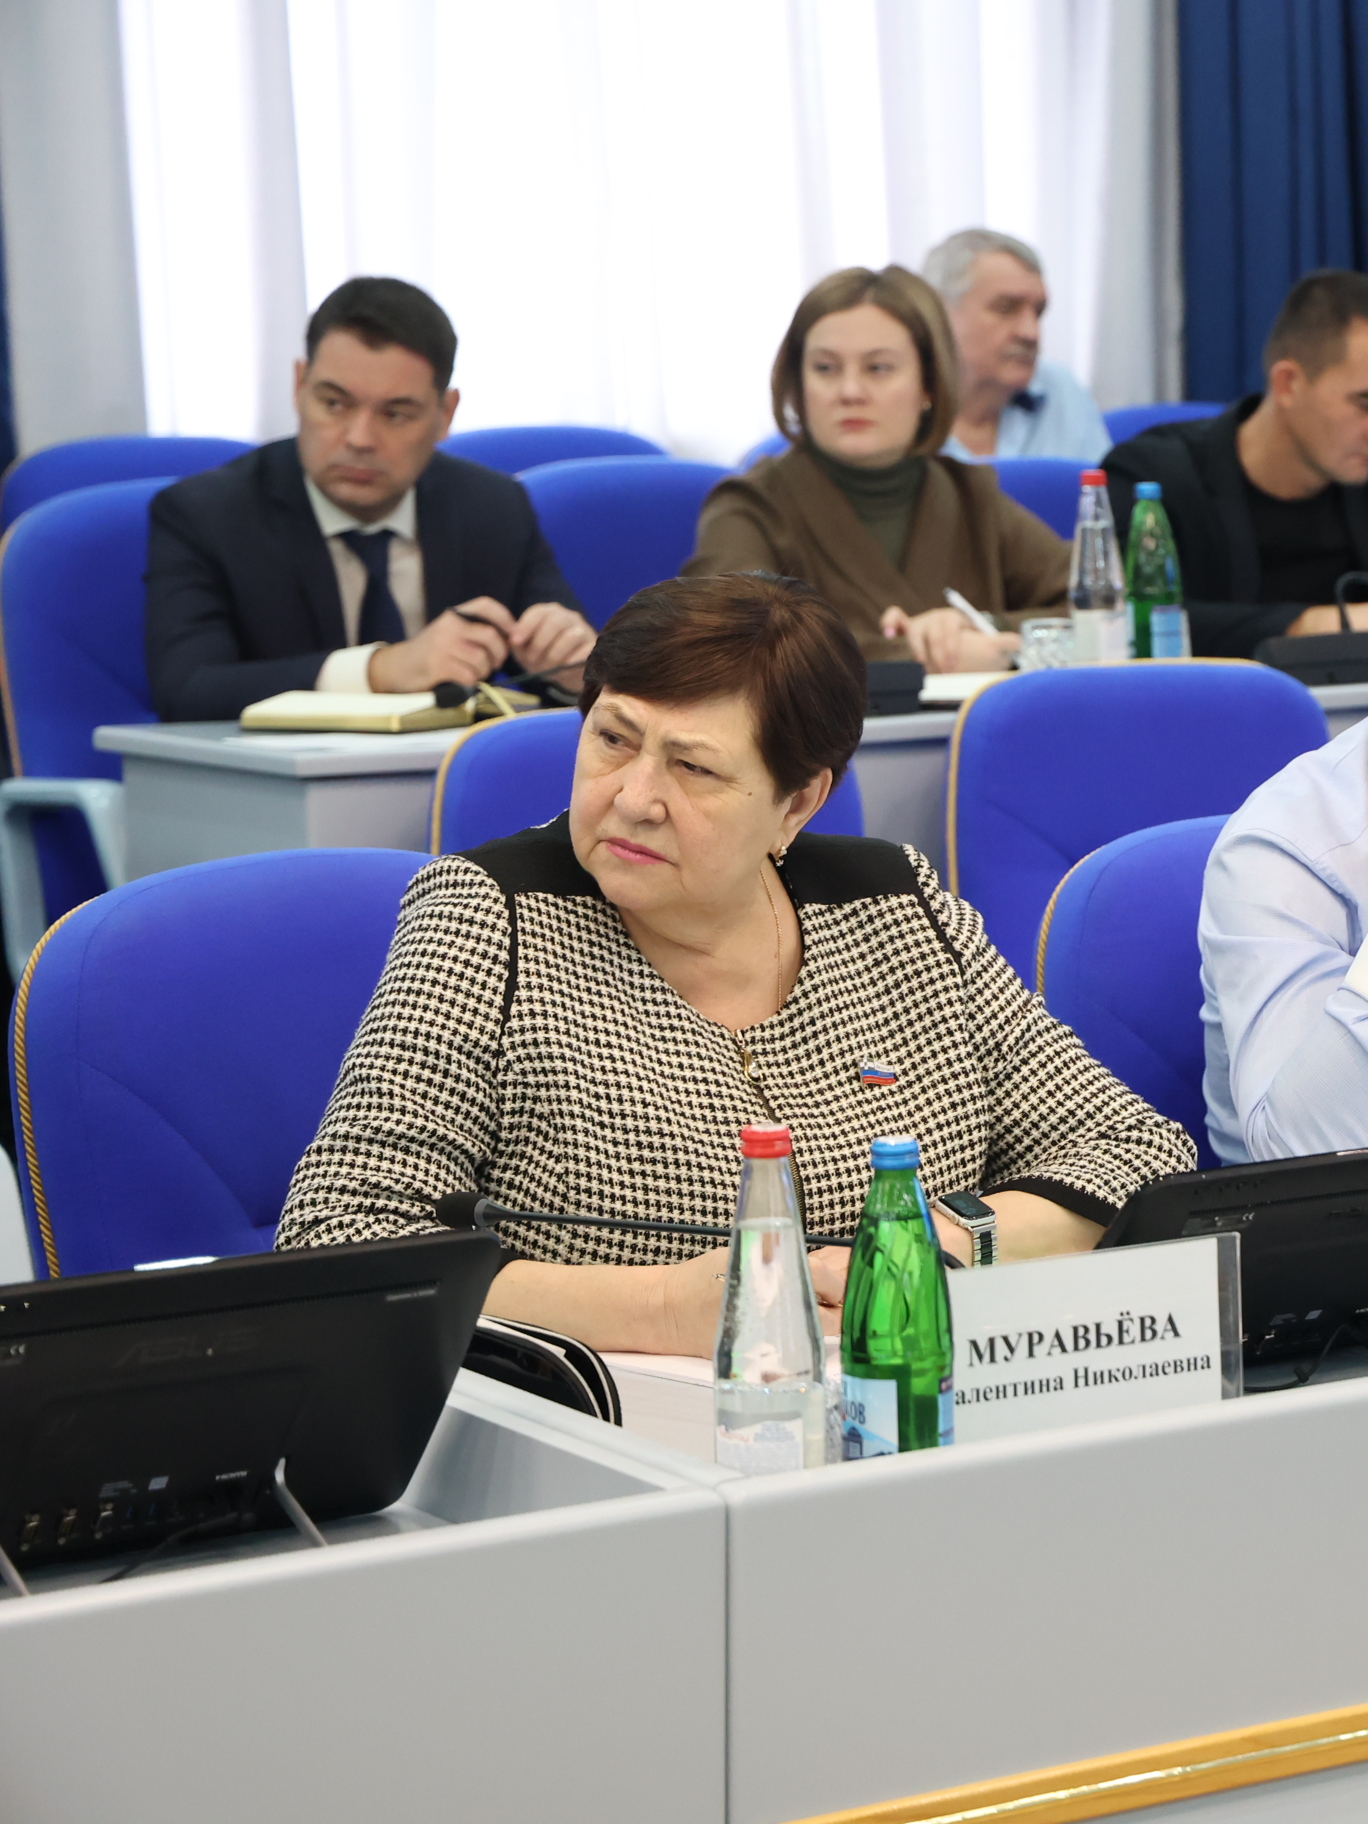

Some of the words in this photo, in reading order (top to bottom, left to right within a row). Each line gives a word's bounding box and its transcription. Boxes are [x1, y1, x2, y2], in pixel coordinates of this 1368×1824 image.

[968, 1311, 1181, 1367] МУРАВЬЁВА
[955, 1376, 1064, 1405] алентина
[1073, 1355, 1211, 1389] Николаевна
